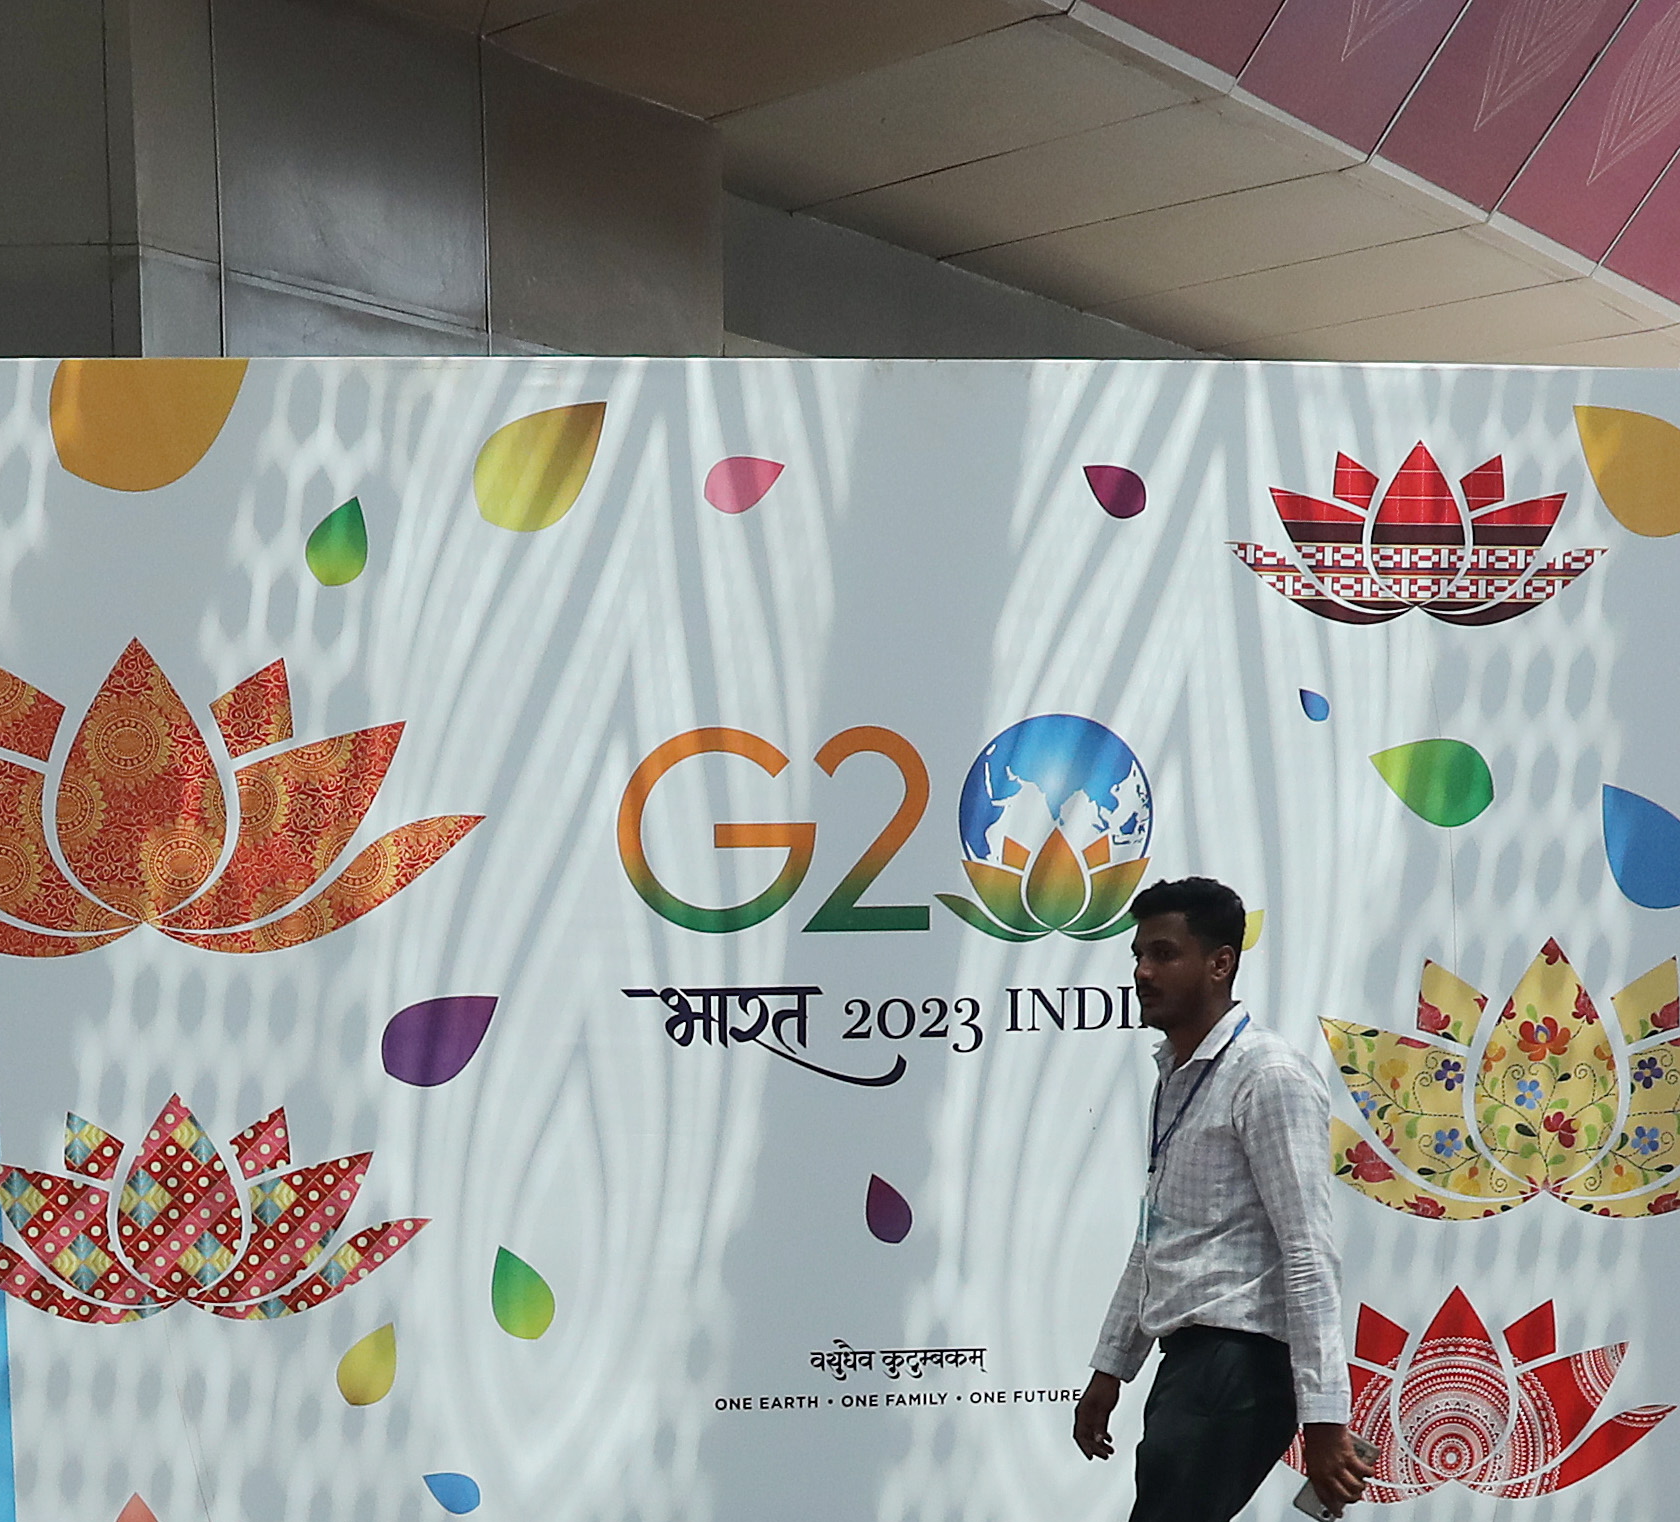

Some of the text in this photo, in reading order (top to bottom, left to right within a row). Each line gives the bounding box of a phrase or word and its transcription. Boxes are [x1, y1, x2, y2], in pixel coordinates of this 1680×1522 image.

[617, 714, 1153, 942] G20
[622, 985, 1149, 1087] भारत 2023 INDI
[810, 1338, 988, 1381] वसुधैव कुटुम्बकम्
[714, 1389, 1081, 1411] ONE EARTH ONE FAMILY ONE FUTURE
